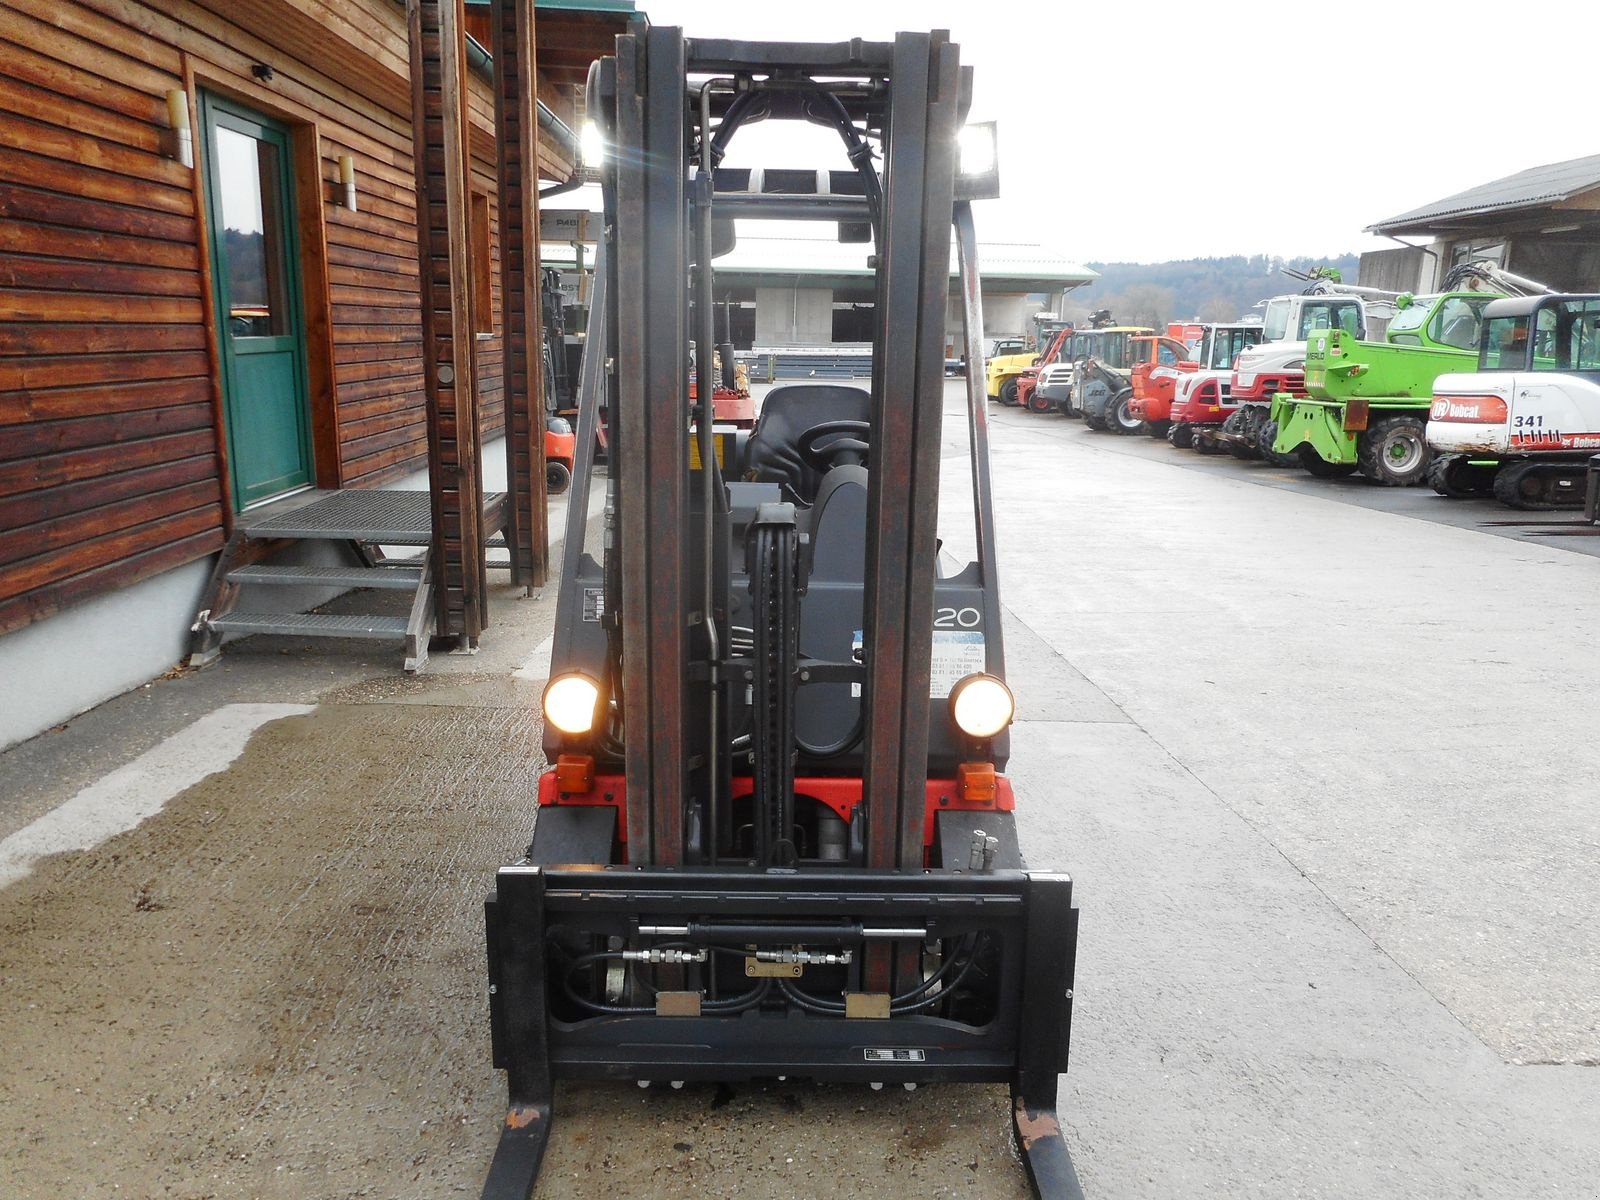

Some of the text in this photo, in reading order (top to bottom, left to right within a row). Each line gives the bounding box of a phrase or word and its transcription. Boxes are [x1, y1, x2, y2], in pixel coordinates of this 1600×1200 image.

[1433, 400, 1480, 419] IR Bobcat
[1514, 415, 1543, 428] 341
[1573, 437, 1600, 448] Bobca
[933, 607, 981, 628] 20
